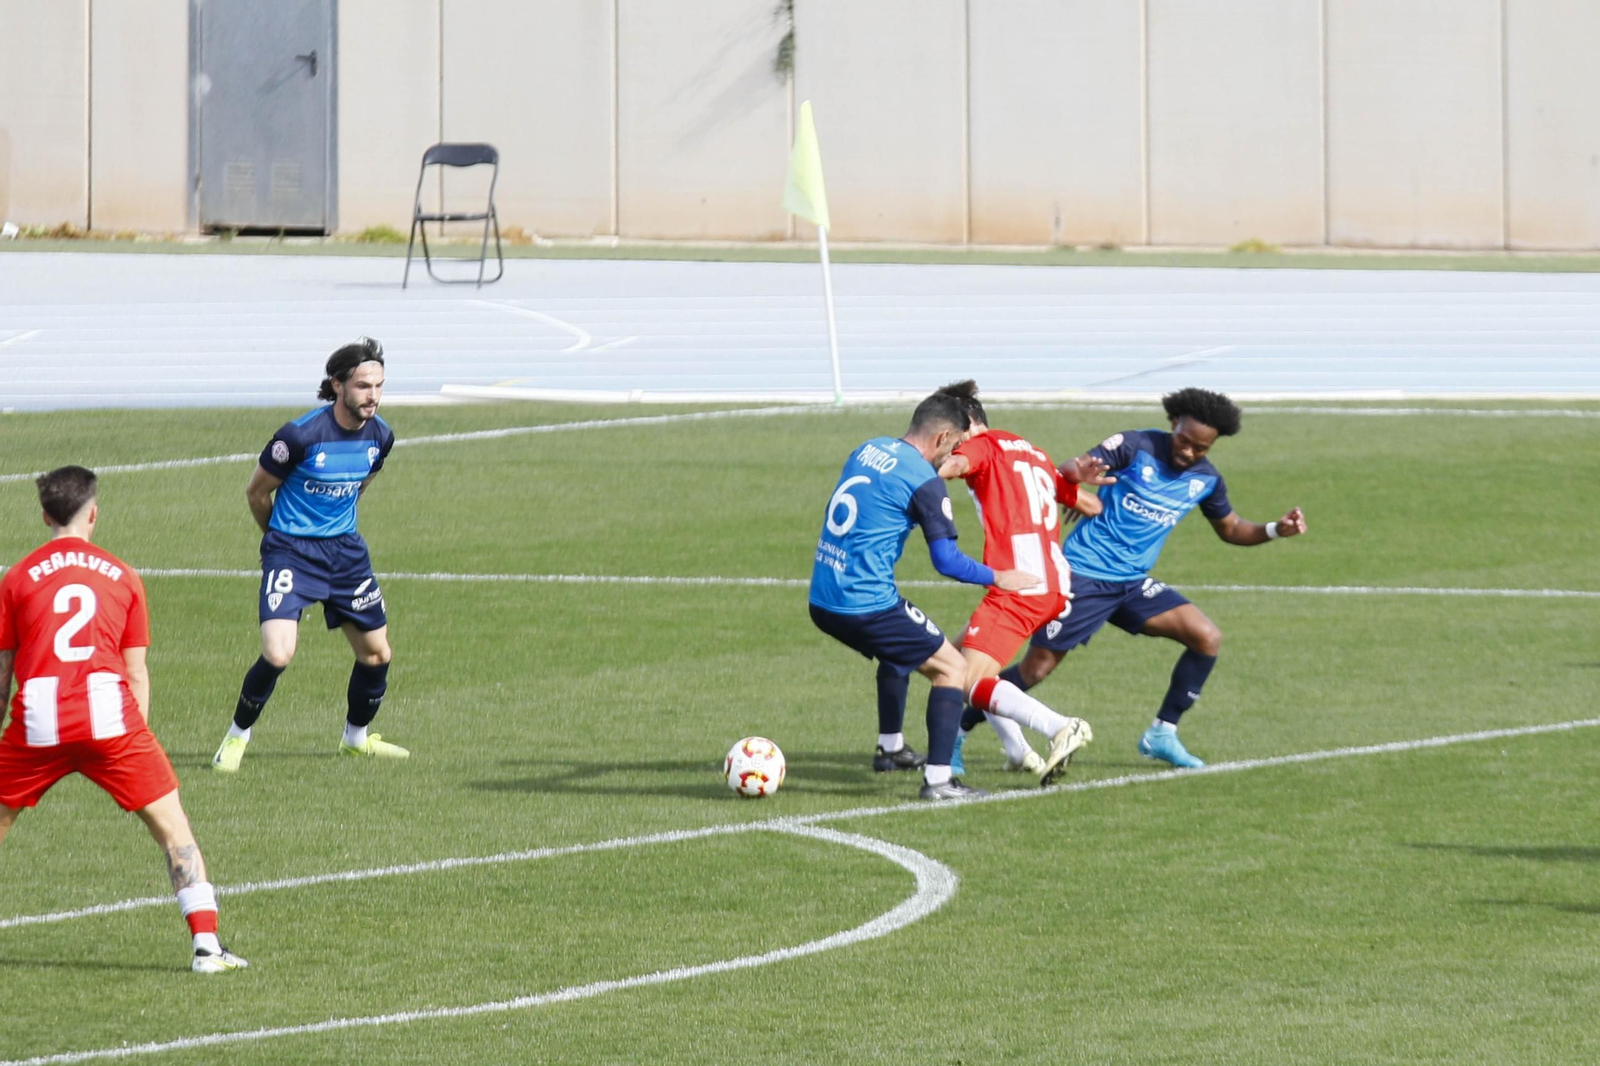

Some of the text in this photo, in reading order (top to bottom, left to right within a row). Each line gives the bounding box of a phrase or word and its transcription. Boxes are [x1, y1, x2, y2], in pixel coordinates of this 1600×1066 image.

[826, 475, 871, 537] 6
[27, 551, 123, 583] PEÑALVER
[266, 568, 294, 595] 18
[53, 583, 97, 663] 2
[904, 600, 925, 625] 6
